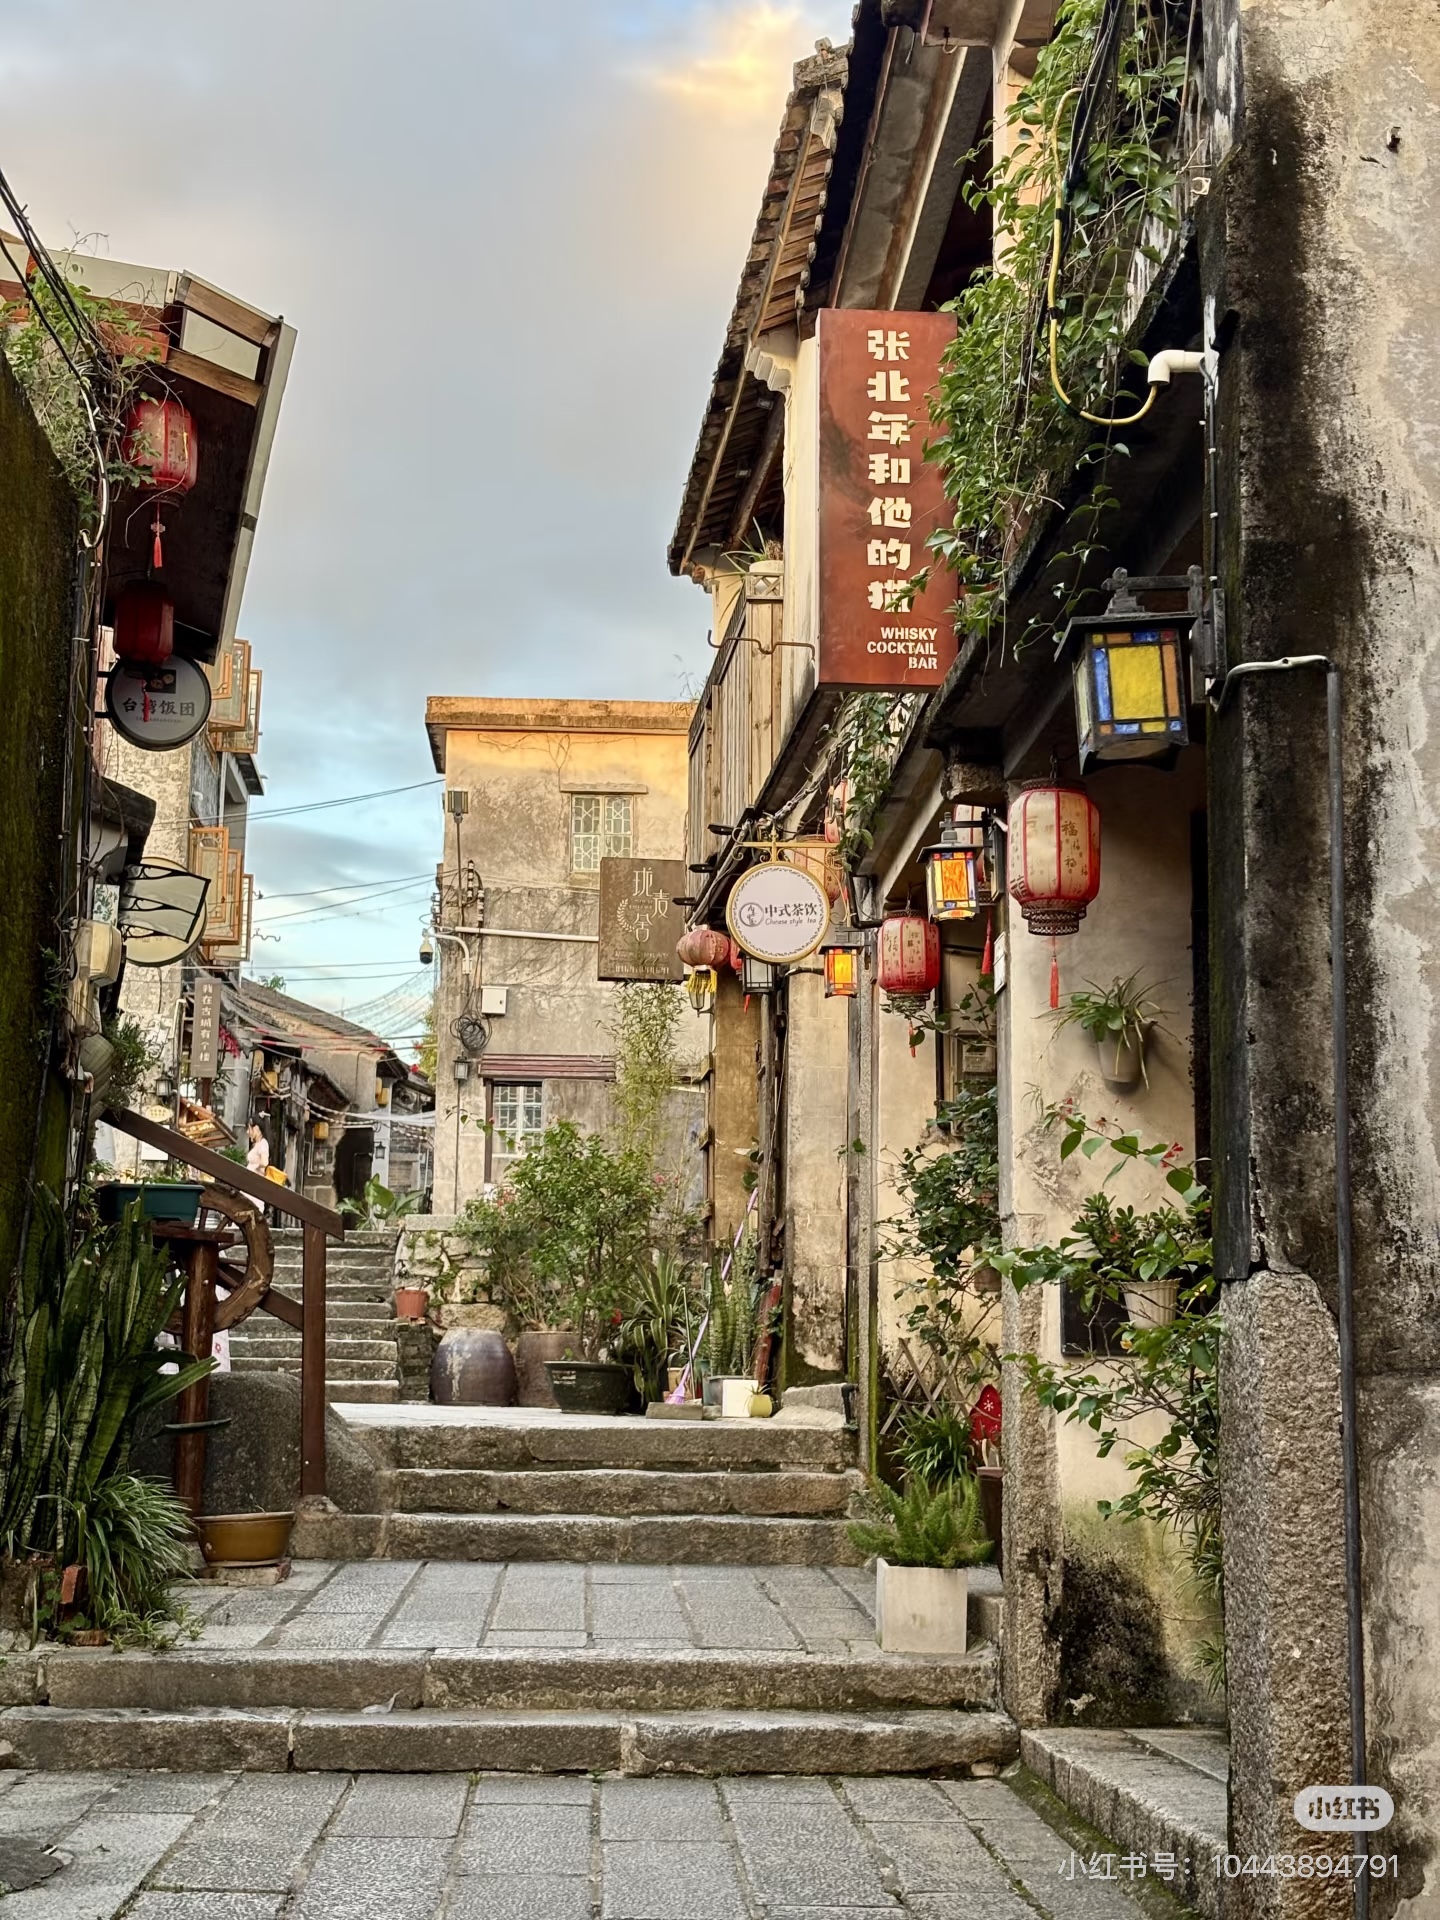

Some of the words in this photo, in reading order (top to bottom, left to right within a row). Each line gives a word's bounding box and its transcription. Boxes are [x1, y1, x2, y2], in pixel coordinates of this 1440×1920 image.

[867, 330, 911, 612] 张北年和他的猫
[880, 626, 938, 640] WHISKY
[866, 641, 938, 655] COCKTAIL
[908, 656, 938, 669] BAR
[764, 903, 818, 918] 中式茶饮
[765, 917, 788, 926] Chinese
[789, 917, 803, 927] style
